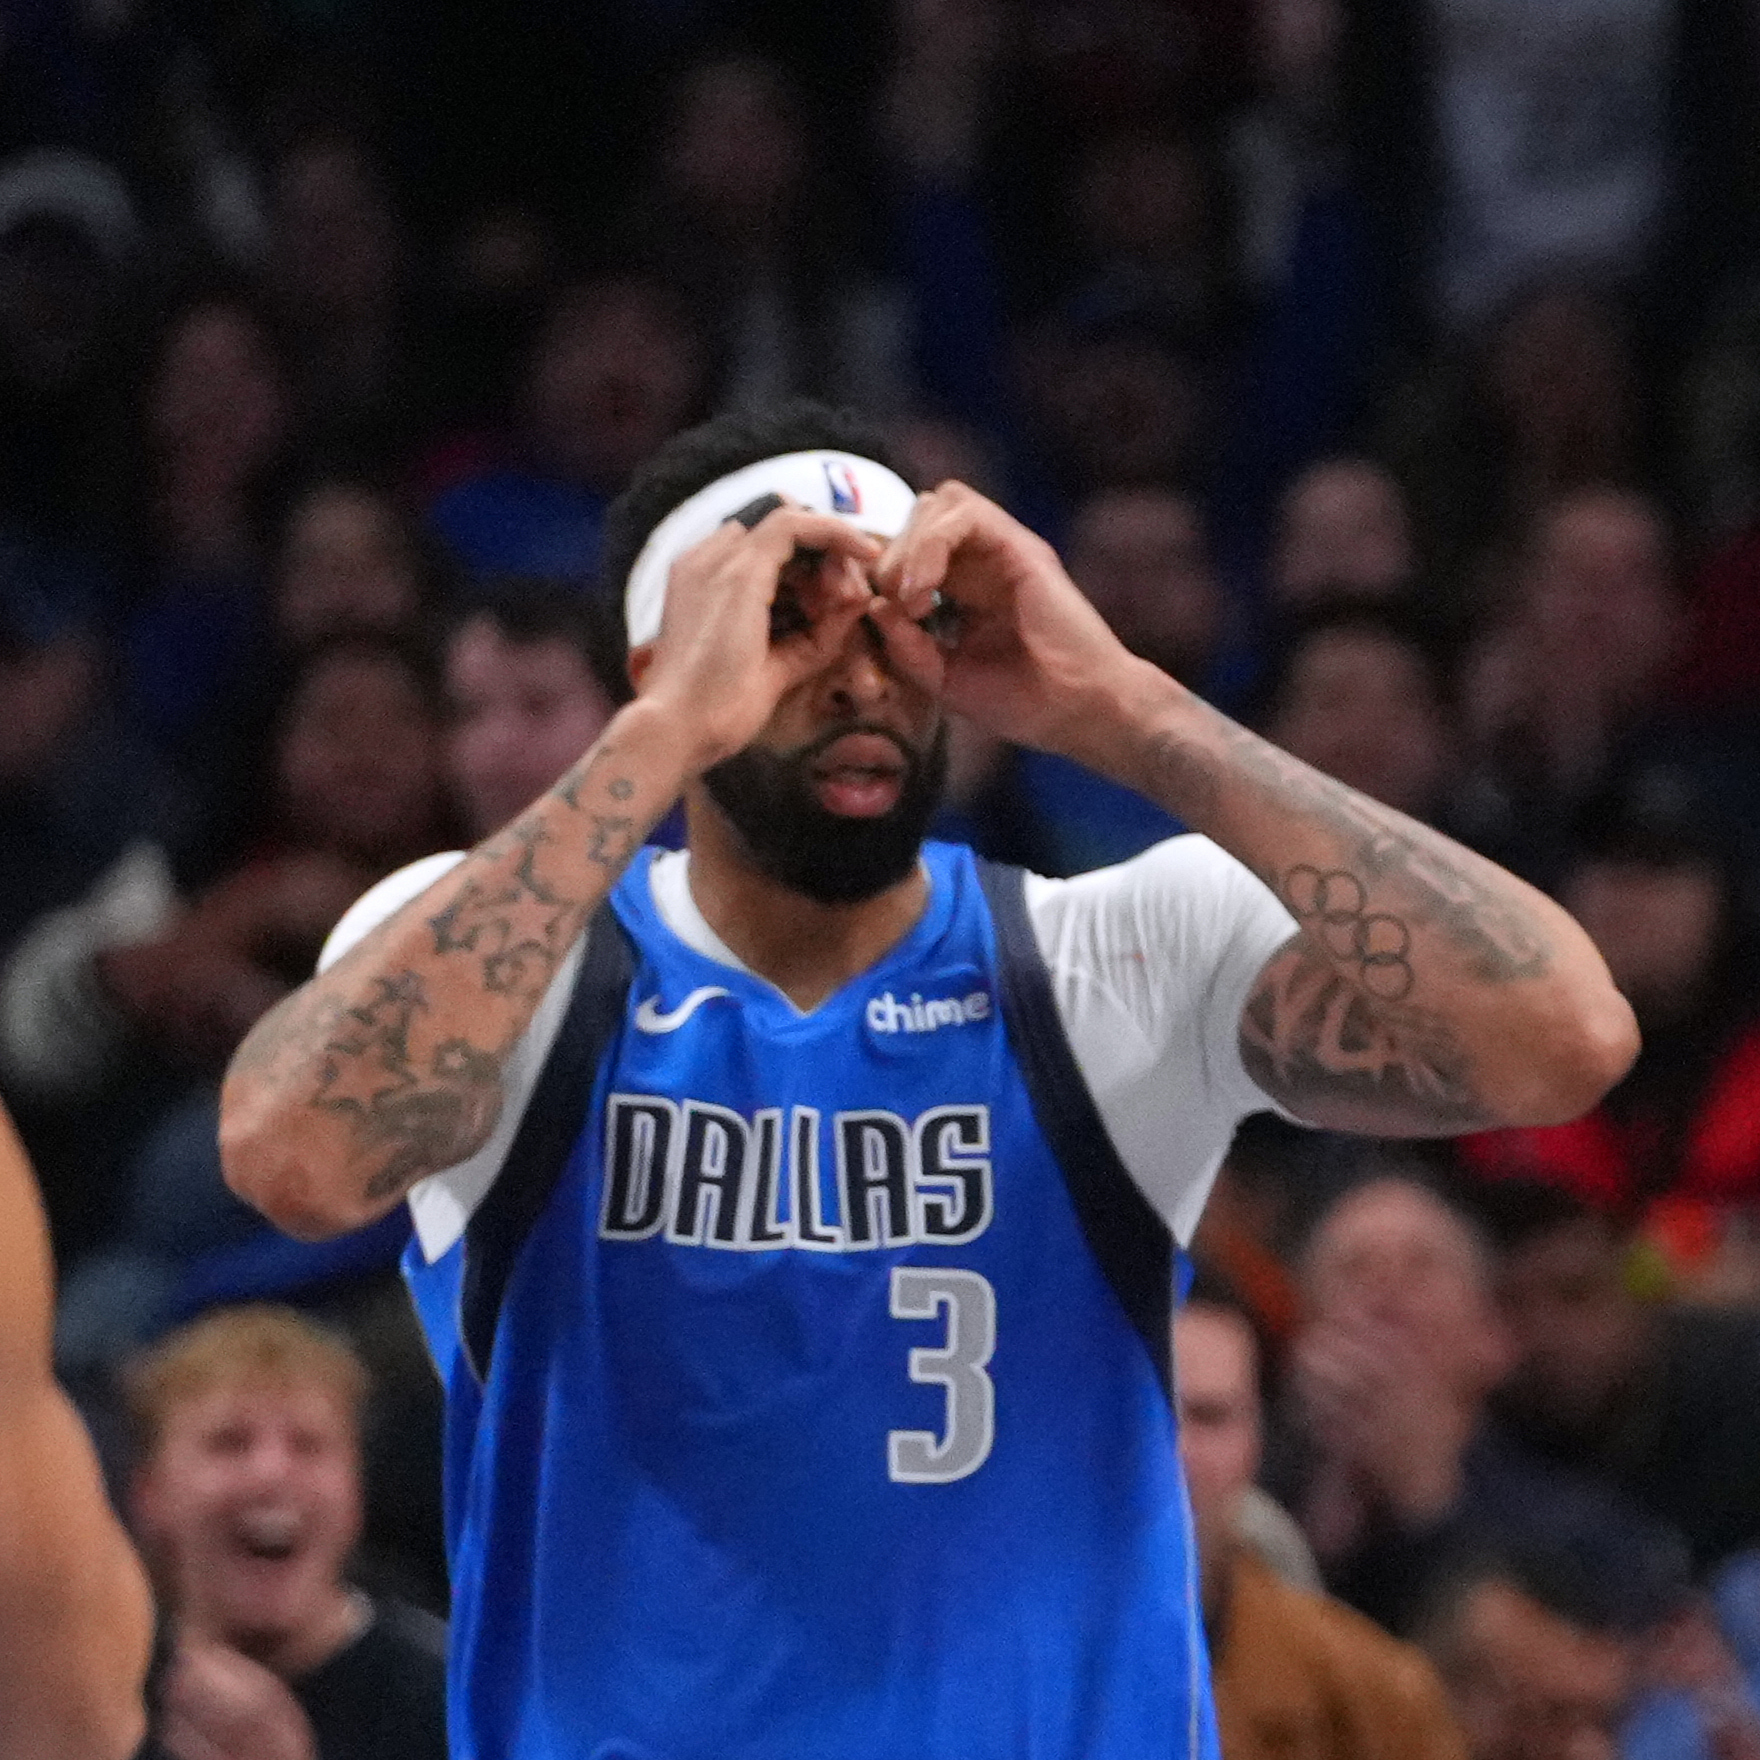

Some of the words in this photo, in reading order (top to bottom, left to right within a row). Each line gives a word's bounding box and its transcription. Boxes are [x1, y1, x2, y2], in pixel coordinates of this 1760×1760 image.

[866, 987, 990, 1034] chime
[599, 1091, 994, 1254] DALLAS
[888, 1266, 997, 1485] 3
